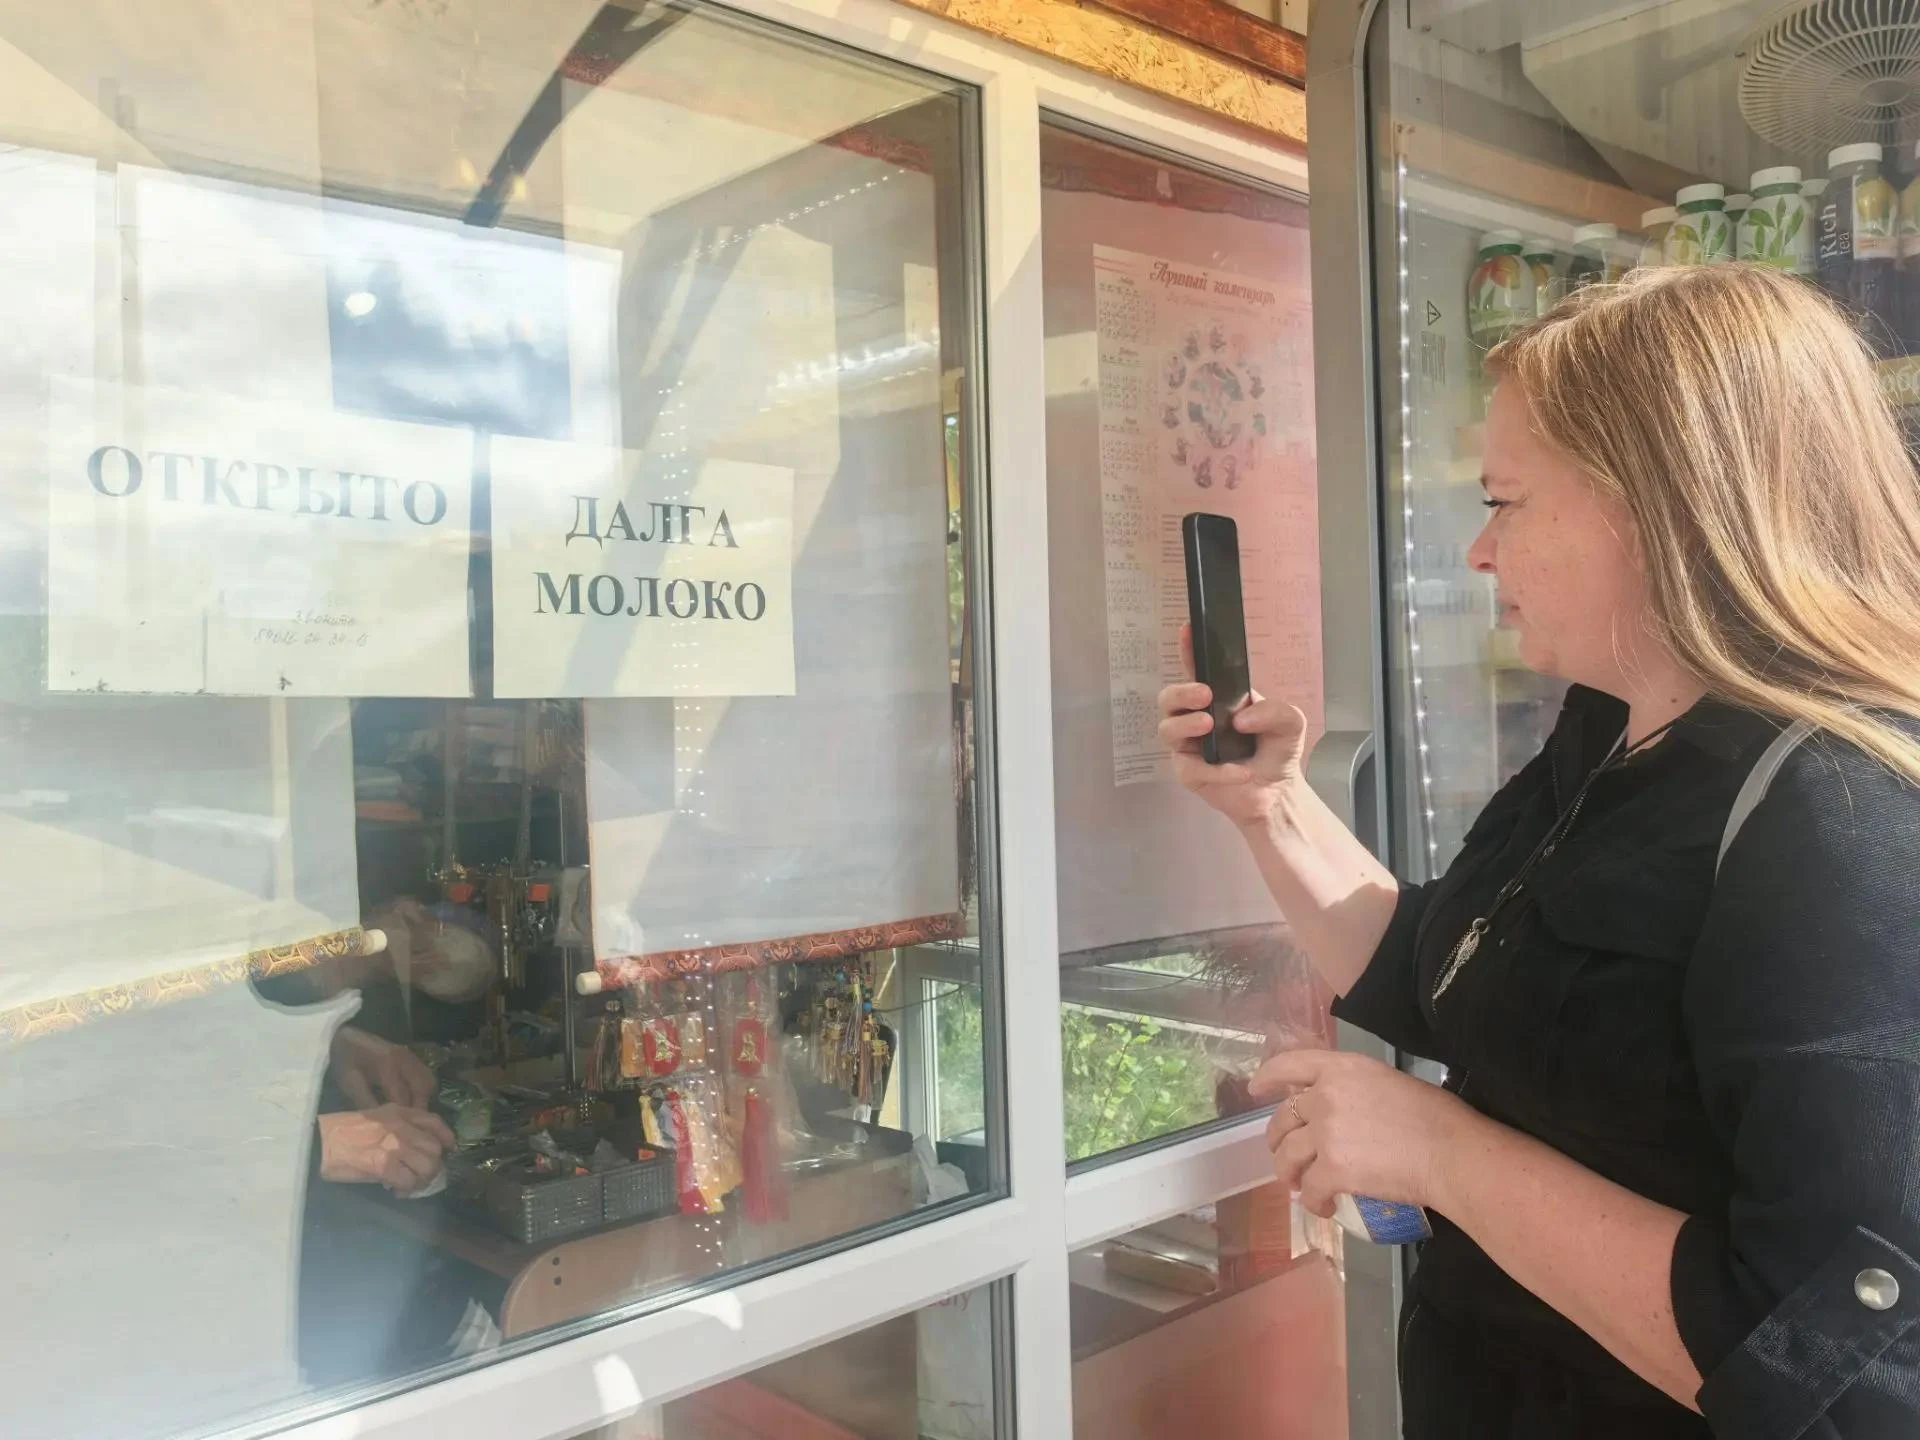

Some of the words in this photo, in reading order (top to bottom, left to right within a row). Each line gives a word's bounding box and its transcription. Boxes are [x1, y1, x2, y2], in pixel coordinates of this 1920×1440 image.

[1820, 203, 1837, 259] Rich
[1839, 231, 1850, 255] tea
[86, 445, 448, 526] ОТКРЫТО
[565, 495, 740, 549] ДАЛГА
[534, 572, 766, 621] МОЛОКО
